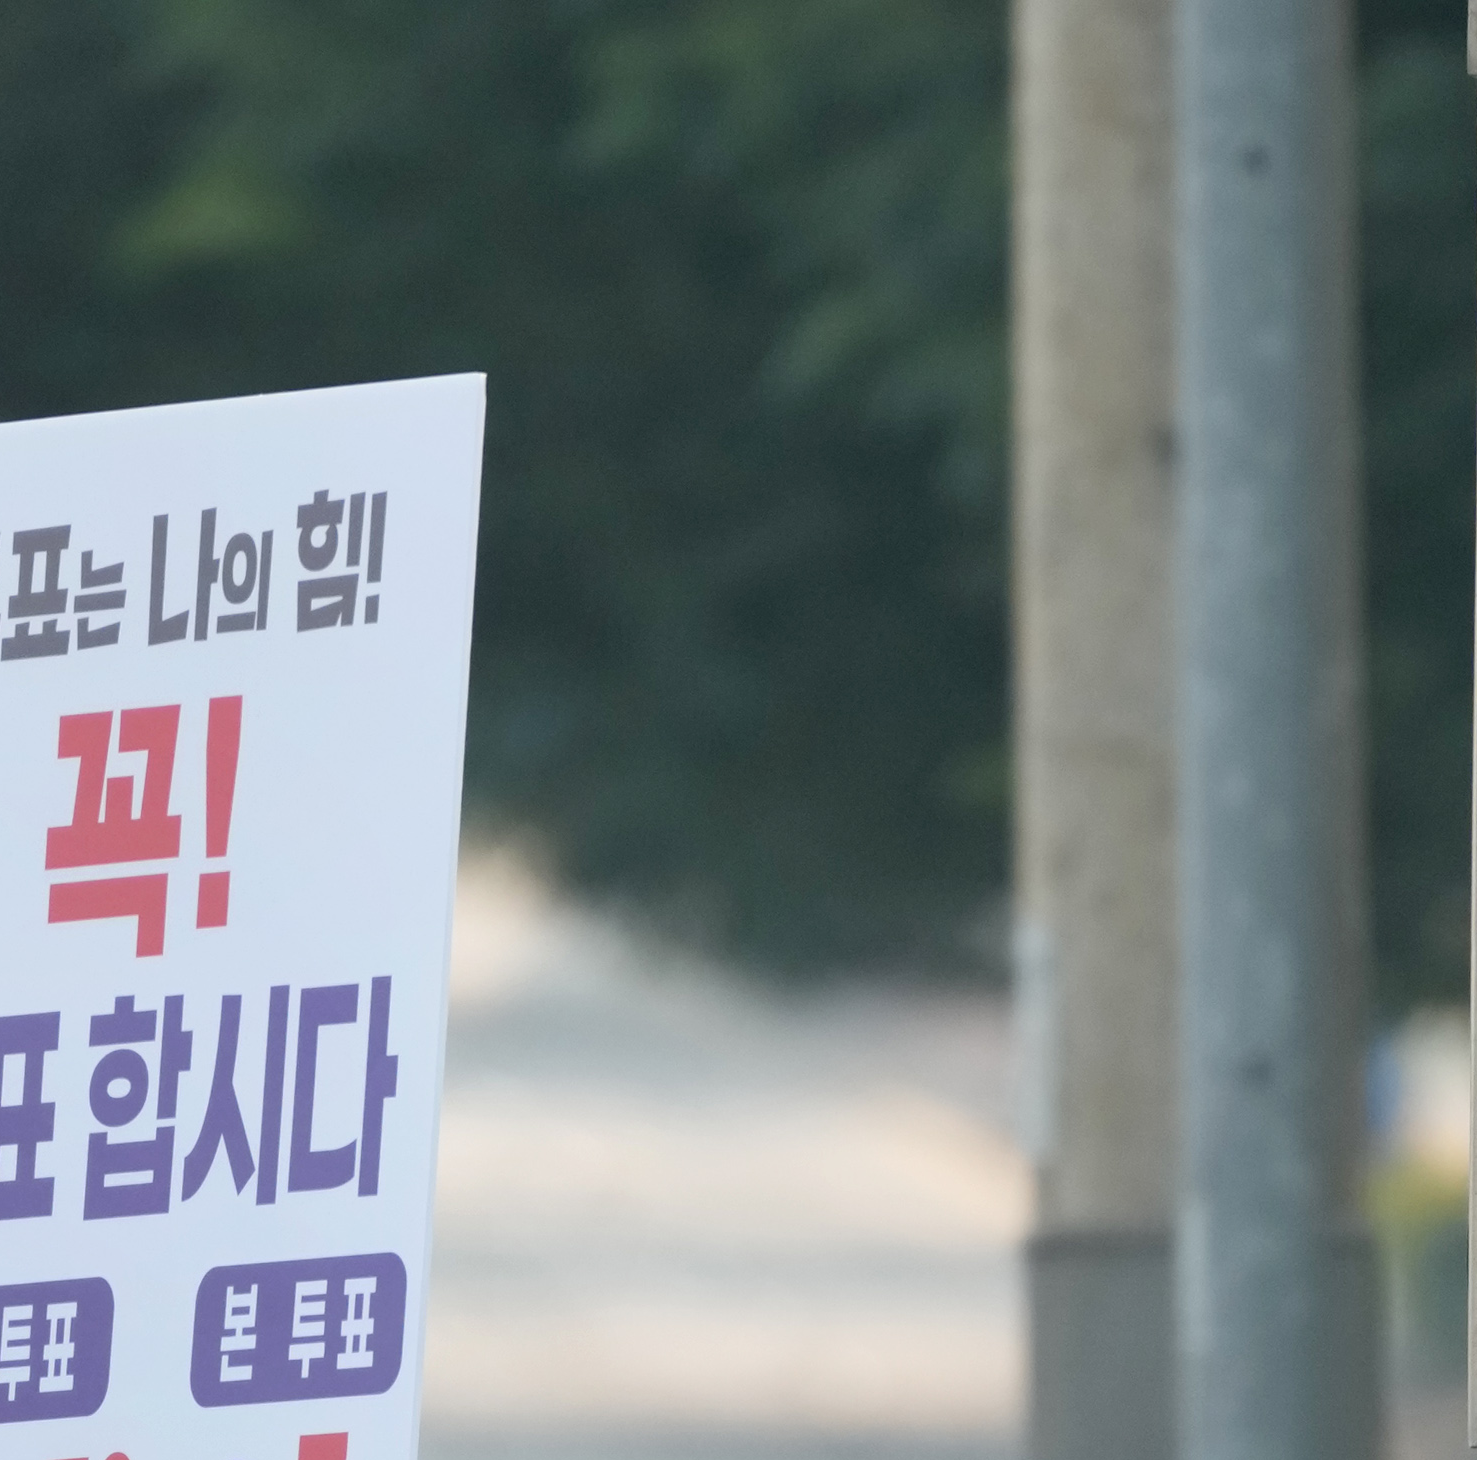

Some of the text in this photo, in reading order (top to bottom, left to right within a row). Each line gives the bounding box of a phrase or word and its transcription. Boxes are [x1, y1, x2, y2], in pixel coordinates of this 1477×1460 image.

[147, 507, 274, 646] 나의
[296, 489, 388, 633] 힘!
[44, 694, 243, 958] 꼭!
[219, 1276, 377, 1383] 본 투표
